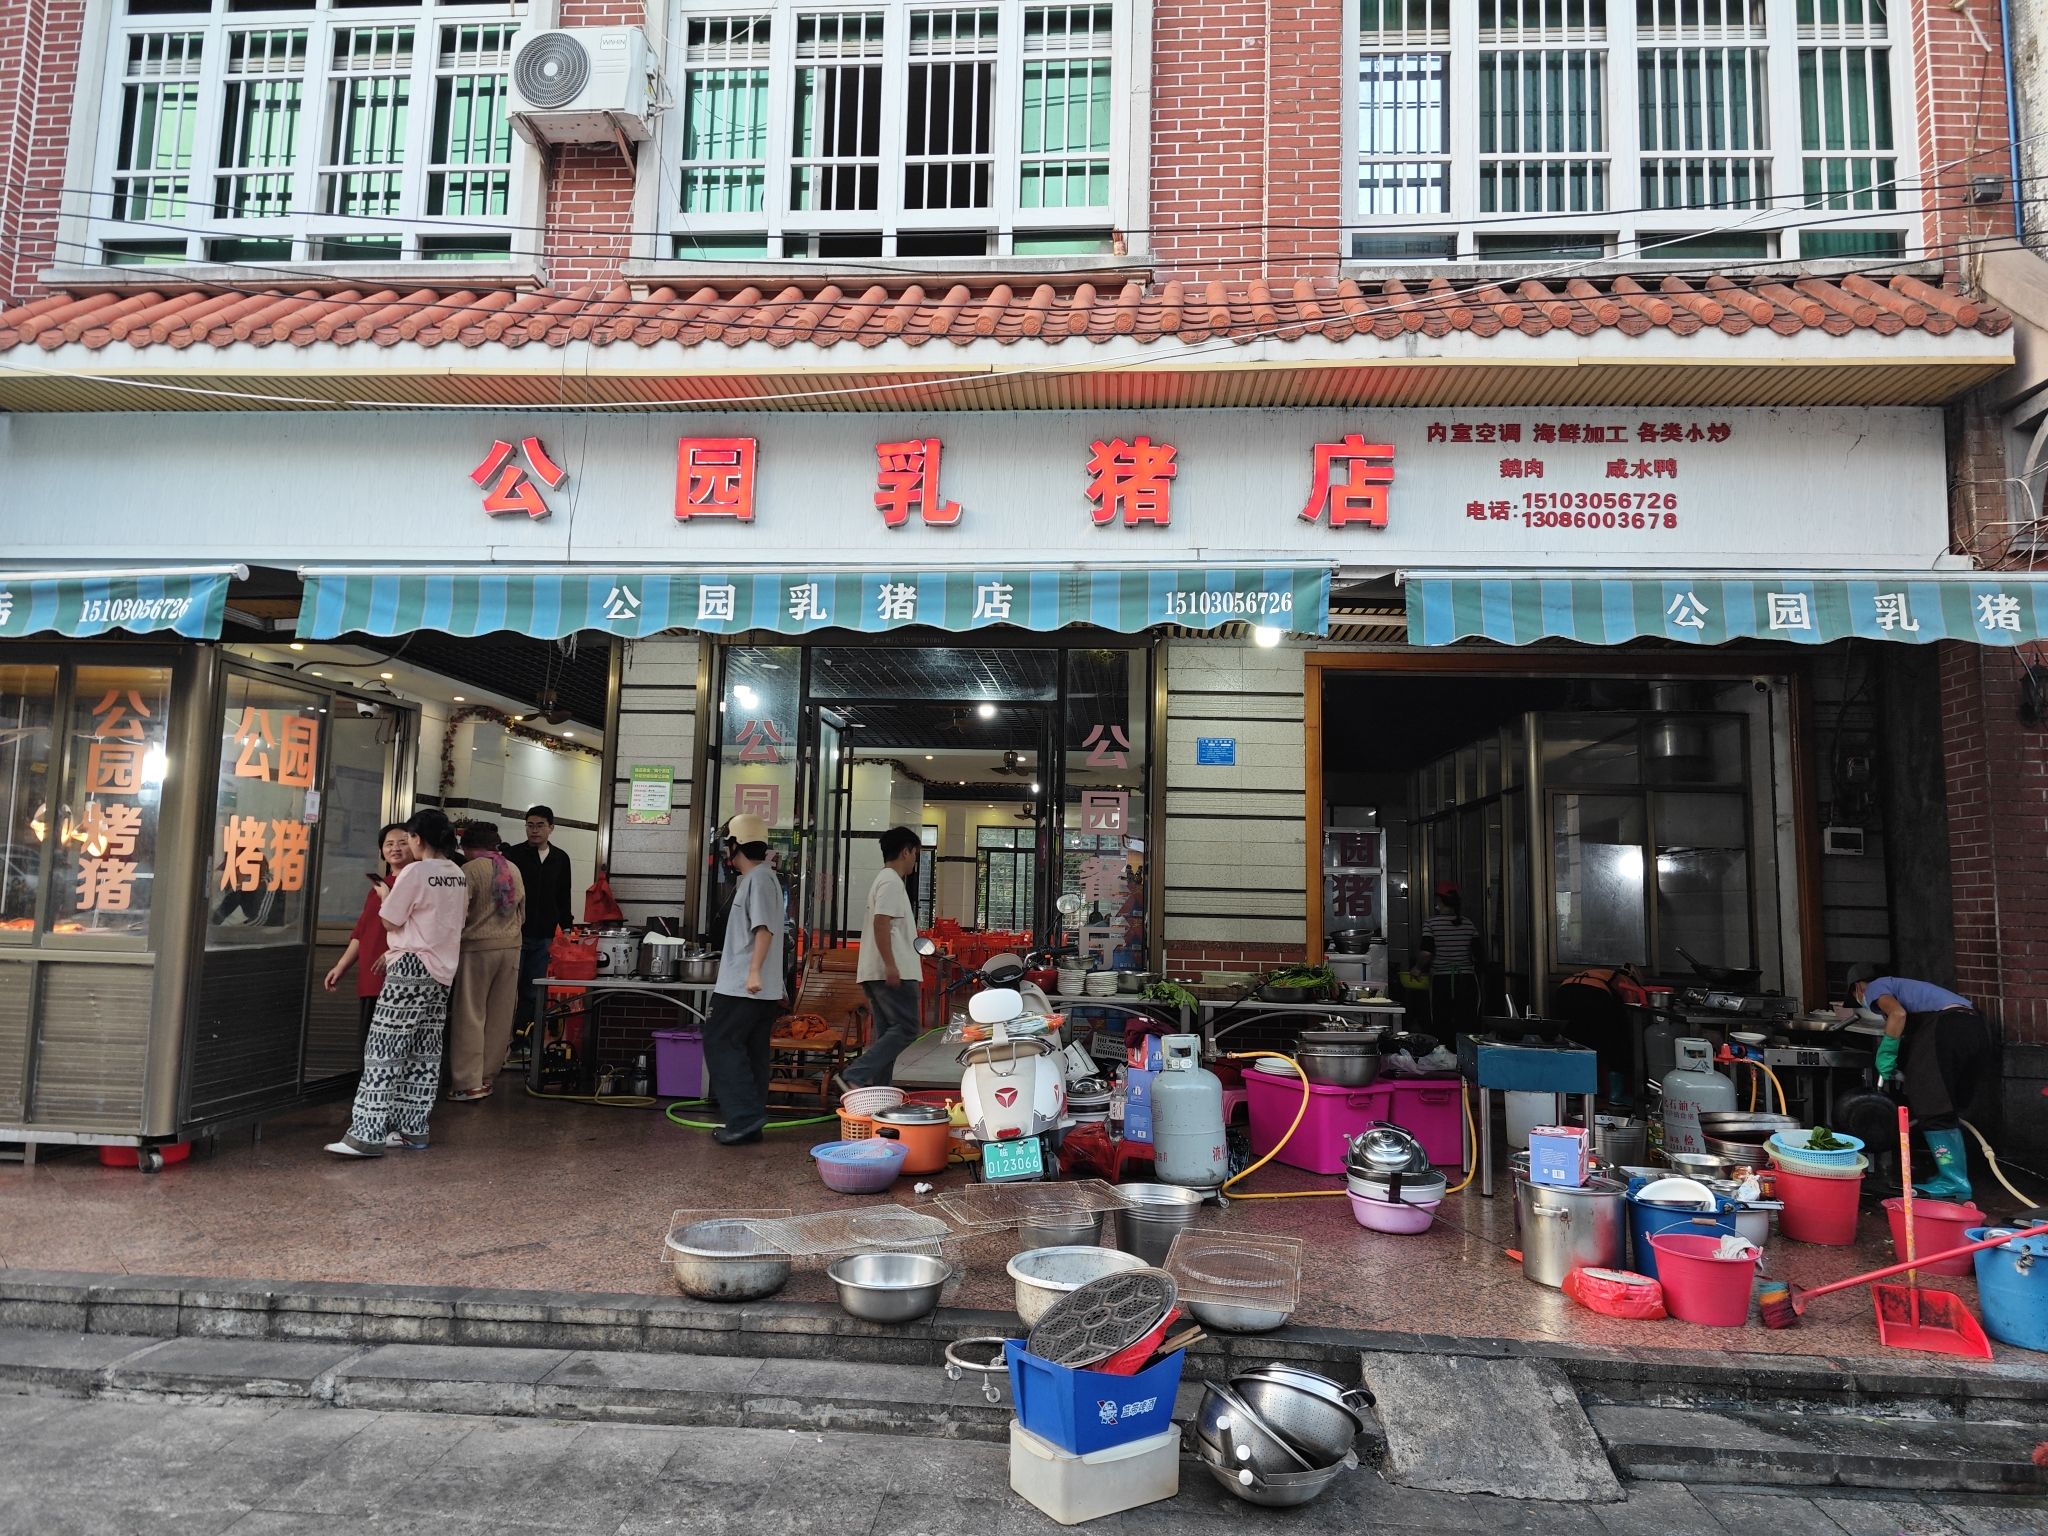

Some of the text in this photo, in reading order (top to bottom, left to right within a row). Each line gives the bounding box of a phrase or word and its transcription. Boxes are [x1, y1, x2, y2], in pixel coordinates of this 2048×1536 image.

[1427, 422, 1731, 443] 内室空调 海鲜加工 各类小炒
[468, 434, 1395, 528] 公园乳猪店
[1500, 458, 1677, 478] 鹅肉 咸水鸭
[1522, 493, 1677, 509] 15103056726
[1522, 512, 1677, 529] 13086003678
[79, 598, 192, 623] 15103056726
[602, 582, 1293, 621] 公园乳猪店 15103056726
[1666, 591, 2021, 632] 公园乳猪
[234, 707, 319, 788] 公园
[76, 689, 150, 910] 公园烤猪
[220, 815, 309, 892] 烤猪
[988, 1156, 1039, 1173] 0123066
